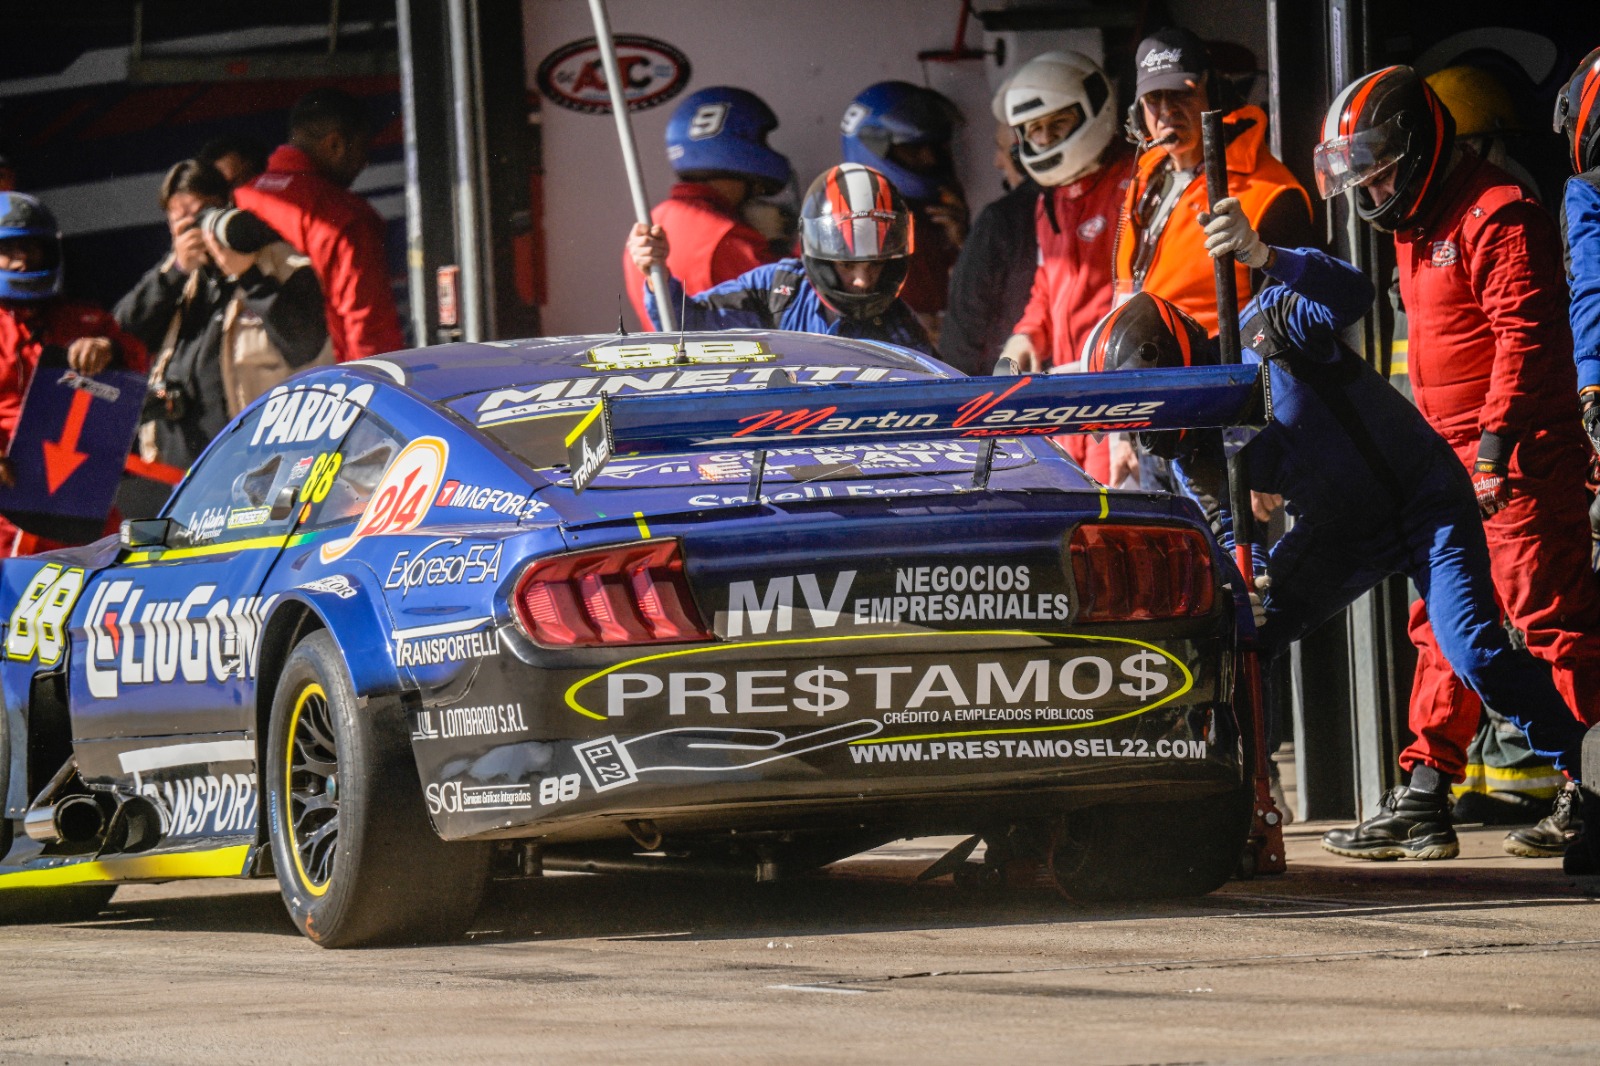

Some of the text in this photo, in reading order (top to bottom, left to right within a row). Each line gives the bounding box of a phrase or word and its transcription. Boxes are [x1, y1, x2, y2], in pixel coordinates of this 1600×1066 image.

[690, 104, 725, 137] 9
[250, 383, 375, 446] PARDO
[732, 376, 1166, 438] Martin Vazquez
[960, 421, 1152, 438] Racing Team
[300, 452, 343, 503] 88
[449, 484, 550, 520] MAGFORCE
[895, 565, 1031, 594] NEGOCIOS
[7, 563, 85, 665] 88
[727, 570, 1070, 638] MV EMPRESARIALES
[606, 650, 1169, 717] PRE$TAMO$
[440, 705, 498, 738] LOMBARDO
[883, 705, 1094, 724] CRÉDITO A EMPLEADOS PÚBLICOS
[585, 745, 626, 783] EL 22
[849, 738, 1207, 764] WWW.PRESTAMOSEL22.COM
[425, 781, 464, 815] SGI
[538, 773, 582, 805] 88
